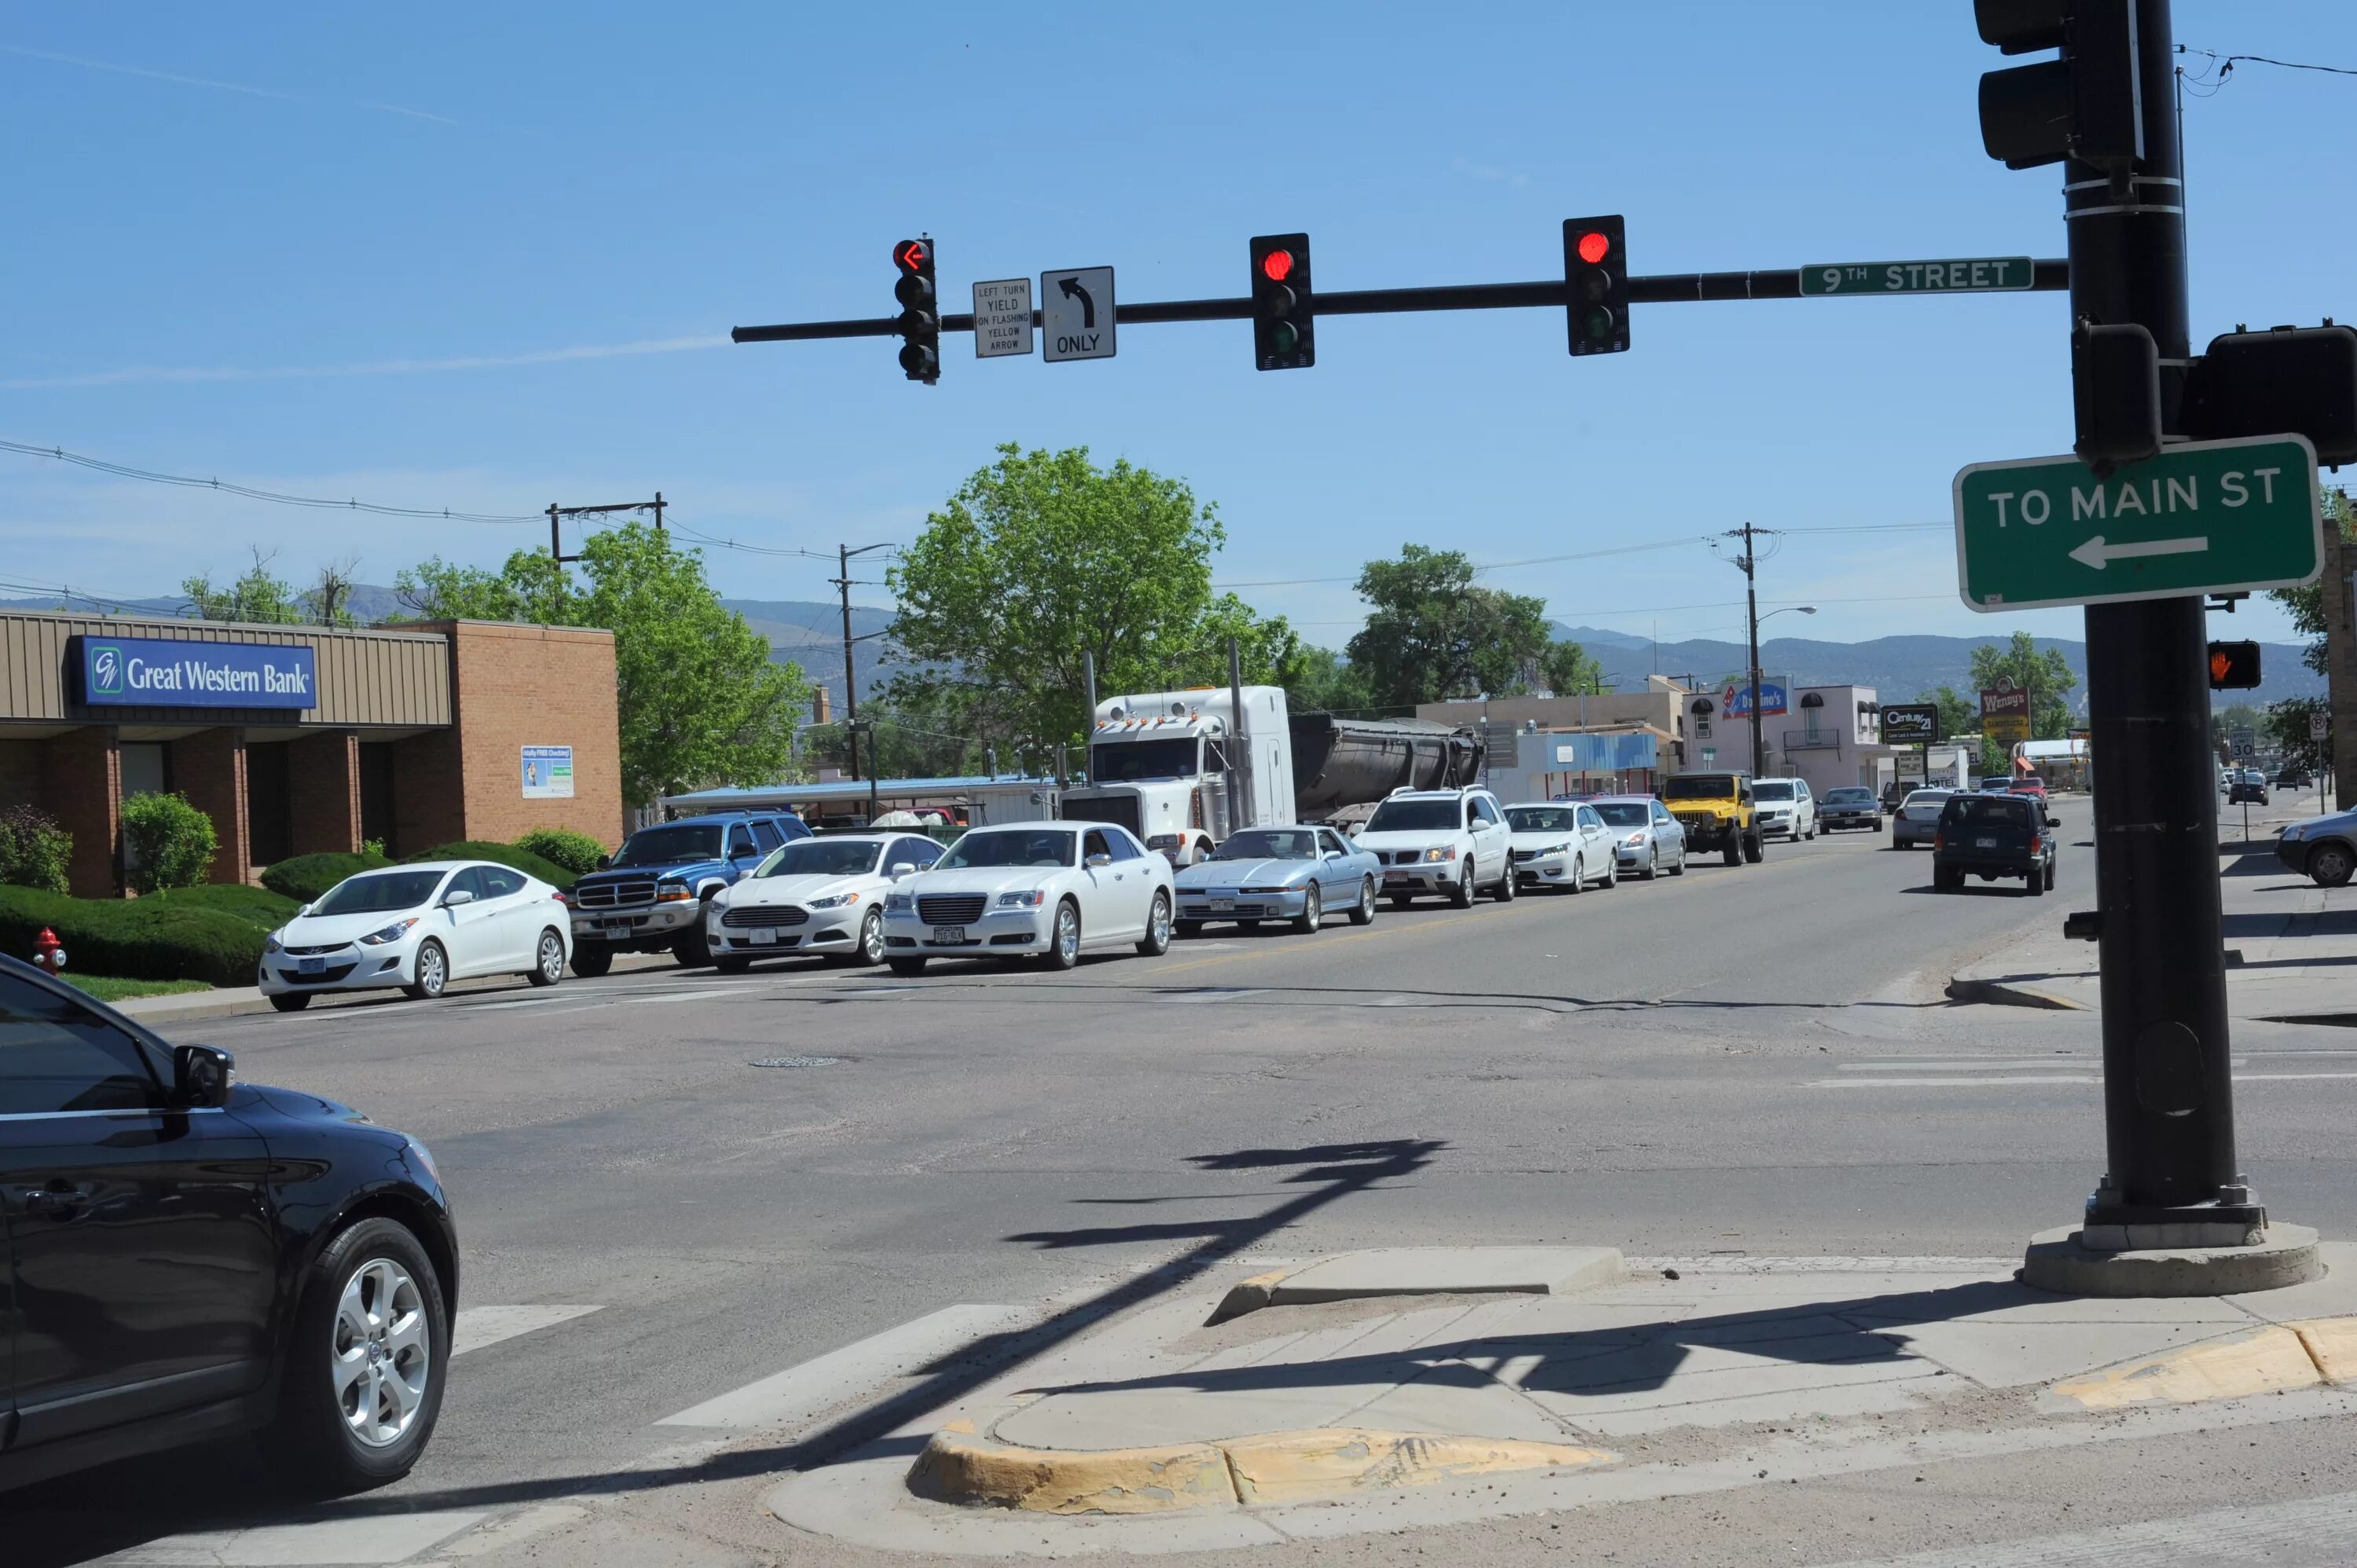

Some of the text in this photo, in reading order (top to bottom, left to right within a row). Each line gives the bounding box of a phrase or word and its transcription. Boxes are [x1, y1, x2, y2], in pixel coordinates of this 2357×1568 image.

[1822, 262, 2010, 293] 9TH STREET
[979, 285, 1025, 297] LEFT TURN
[988, 299, 1018, 312] YIELD
[978, 313, 1028, 326] ON FLASHING
[988, 328, 1020, 338] YELLOW
[991, 340, 1018, 350] ARROW
[1058, 334, 1100, 353] ONLY
[1988, 467, 2281, 527] TO MAIN ST
[127, 658, 183, 690] Great
[185, 661, 259, 691] Western
[1887, 711, 1931, 729] Century 21
[2234, 745, 2252, 755] 30
